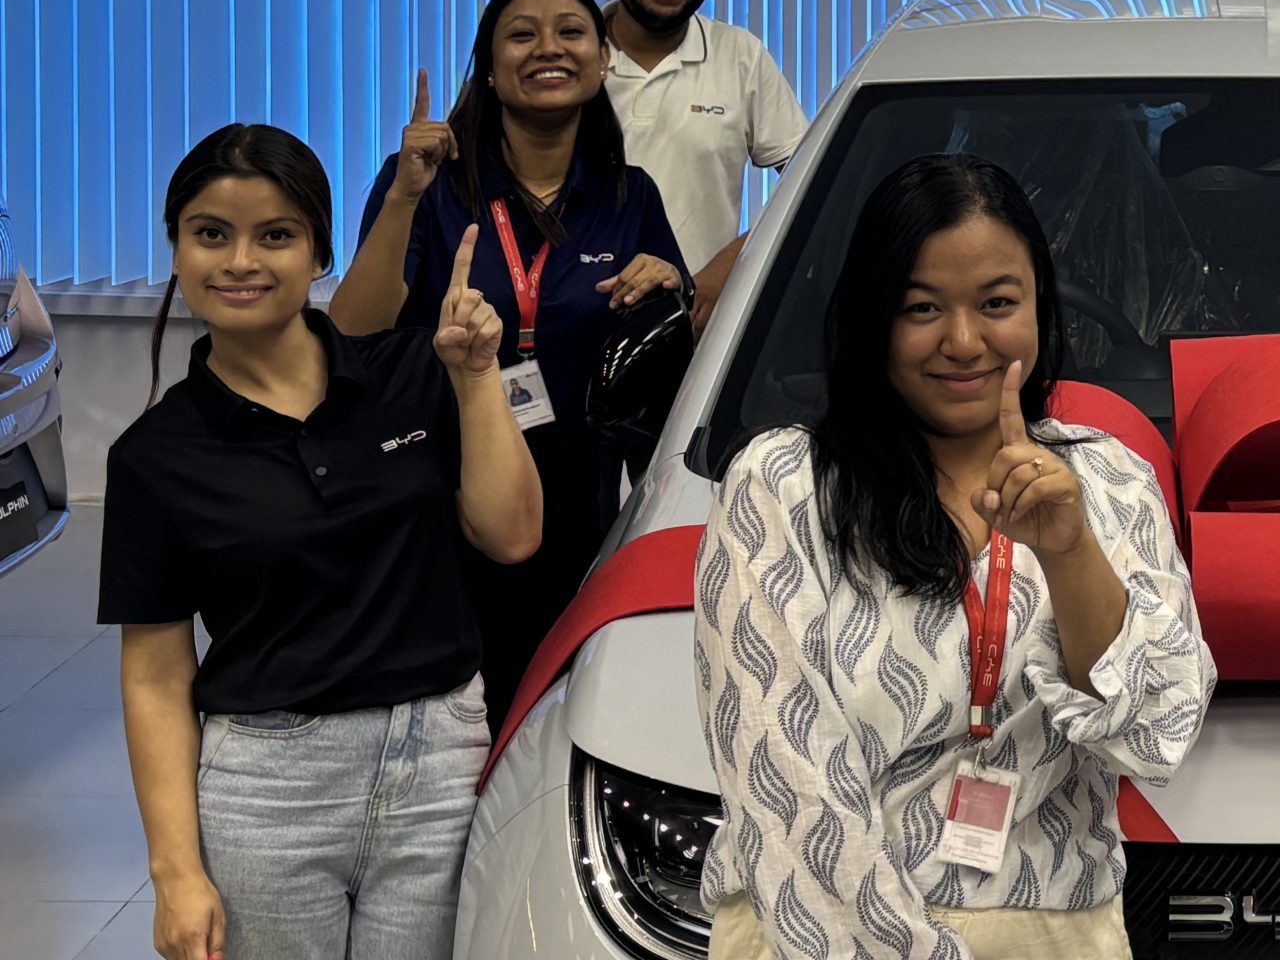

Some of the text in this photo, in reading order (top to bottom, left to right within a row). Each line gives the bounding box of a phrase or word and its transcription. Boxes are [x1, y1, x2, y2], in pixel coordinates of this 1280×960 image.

[690, 104, 725, 115] BYD
[579, 253, 614, 264] BYD
[380, 430, 427, 452] BYD
[996, 534, 1007, 569] BYD
[983, 644, 997, 687] BYD
